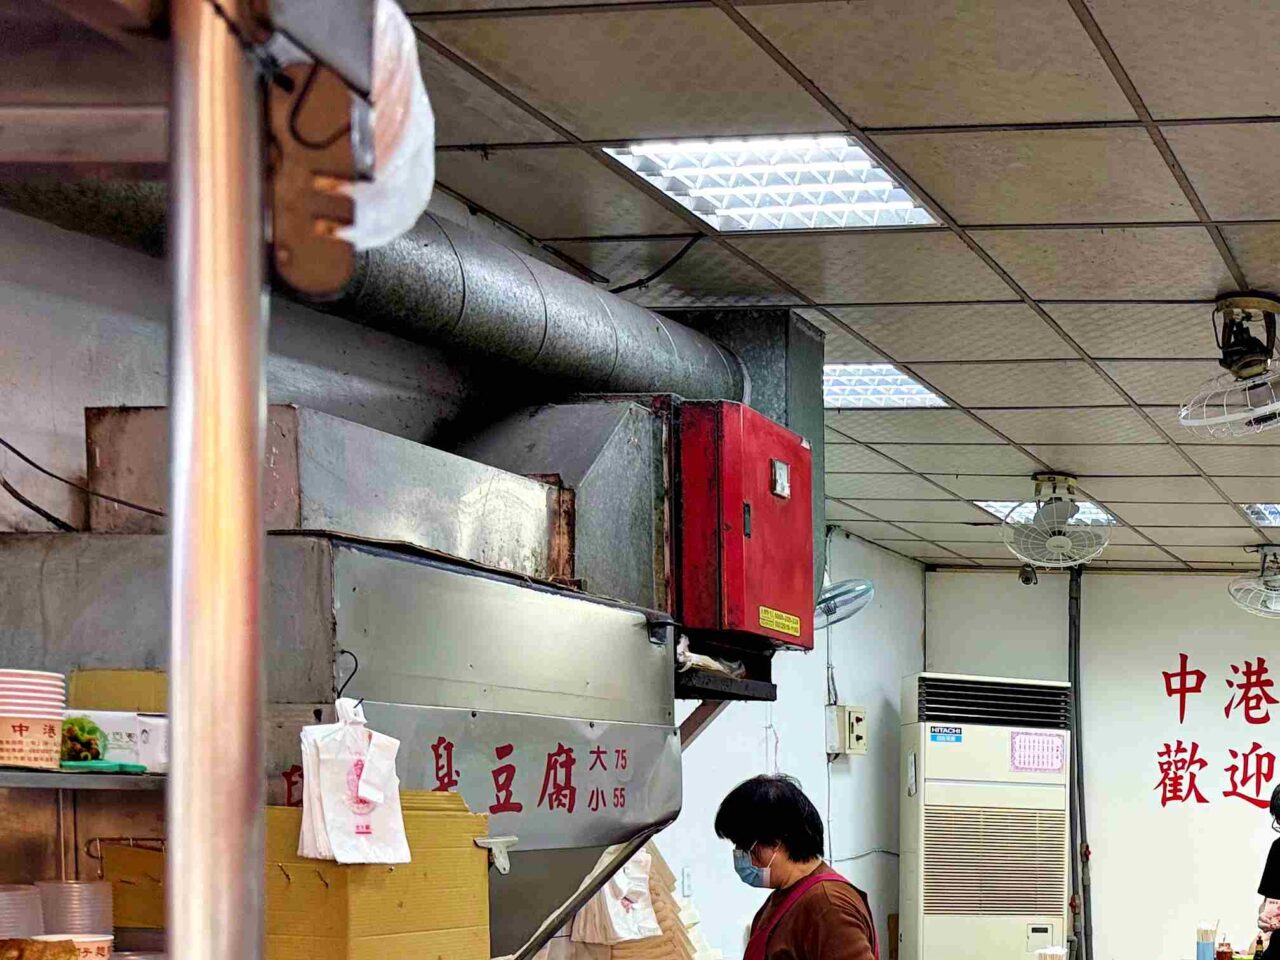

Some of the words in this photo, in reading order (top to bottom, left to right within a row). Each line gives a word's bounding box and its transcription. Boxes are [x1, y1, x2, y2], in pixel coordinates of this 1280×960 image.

[933, 726, 961, 734] HITACHI
[431, 736, 577, 814] 臭豆腐
[589, 745, 608, 772] 大
[614, 749, 628, 770] 75
[588, 786, 607, 812] 小
[613, 787, 626, 809] 55
